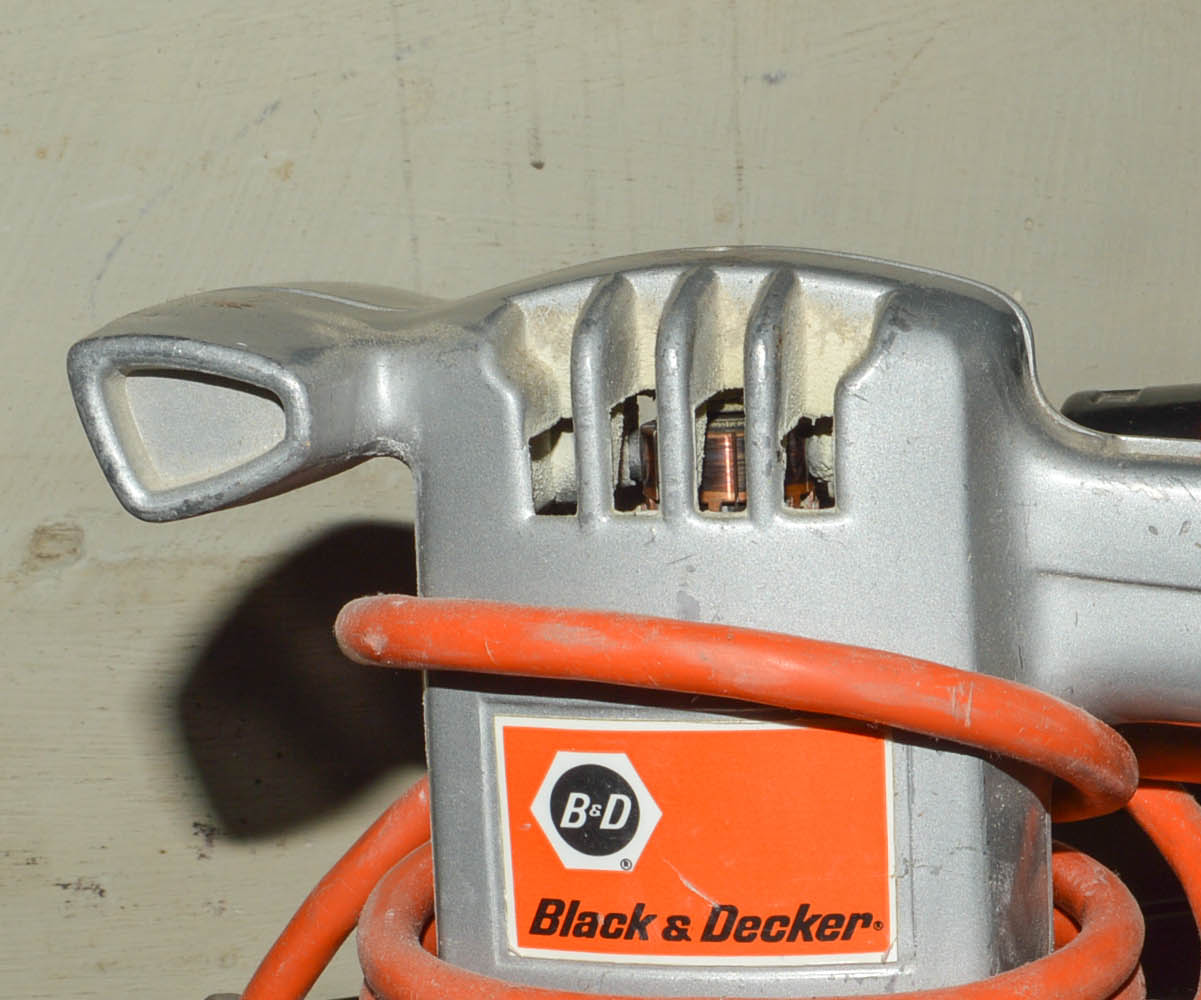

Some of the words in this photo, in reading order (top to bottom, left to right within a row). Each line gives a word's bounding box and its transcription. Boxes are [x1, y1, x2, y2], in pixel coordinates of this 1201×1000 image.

[559, 791, 632, 831] B&D
[528, 897, 658, 942] Black
[661, 915, 692, 942] &
